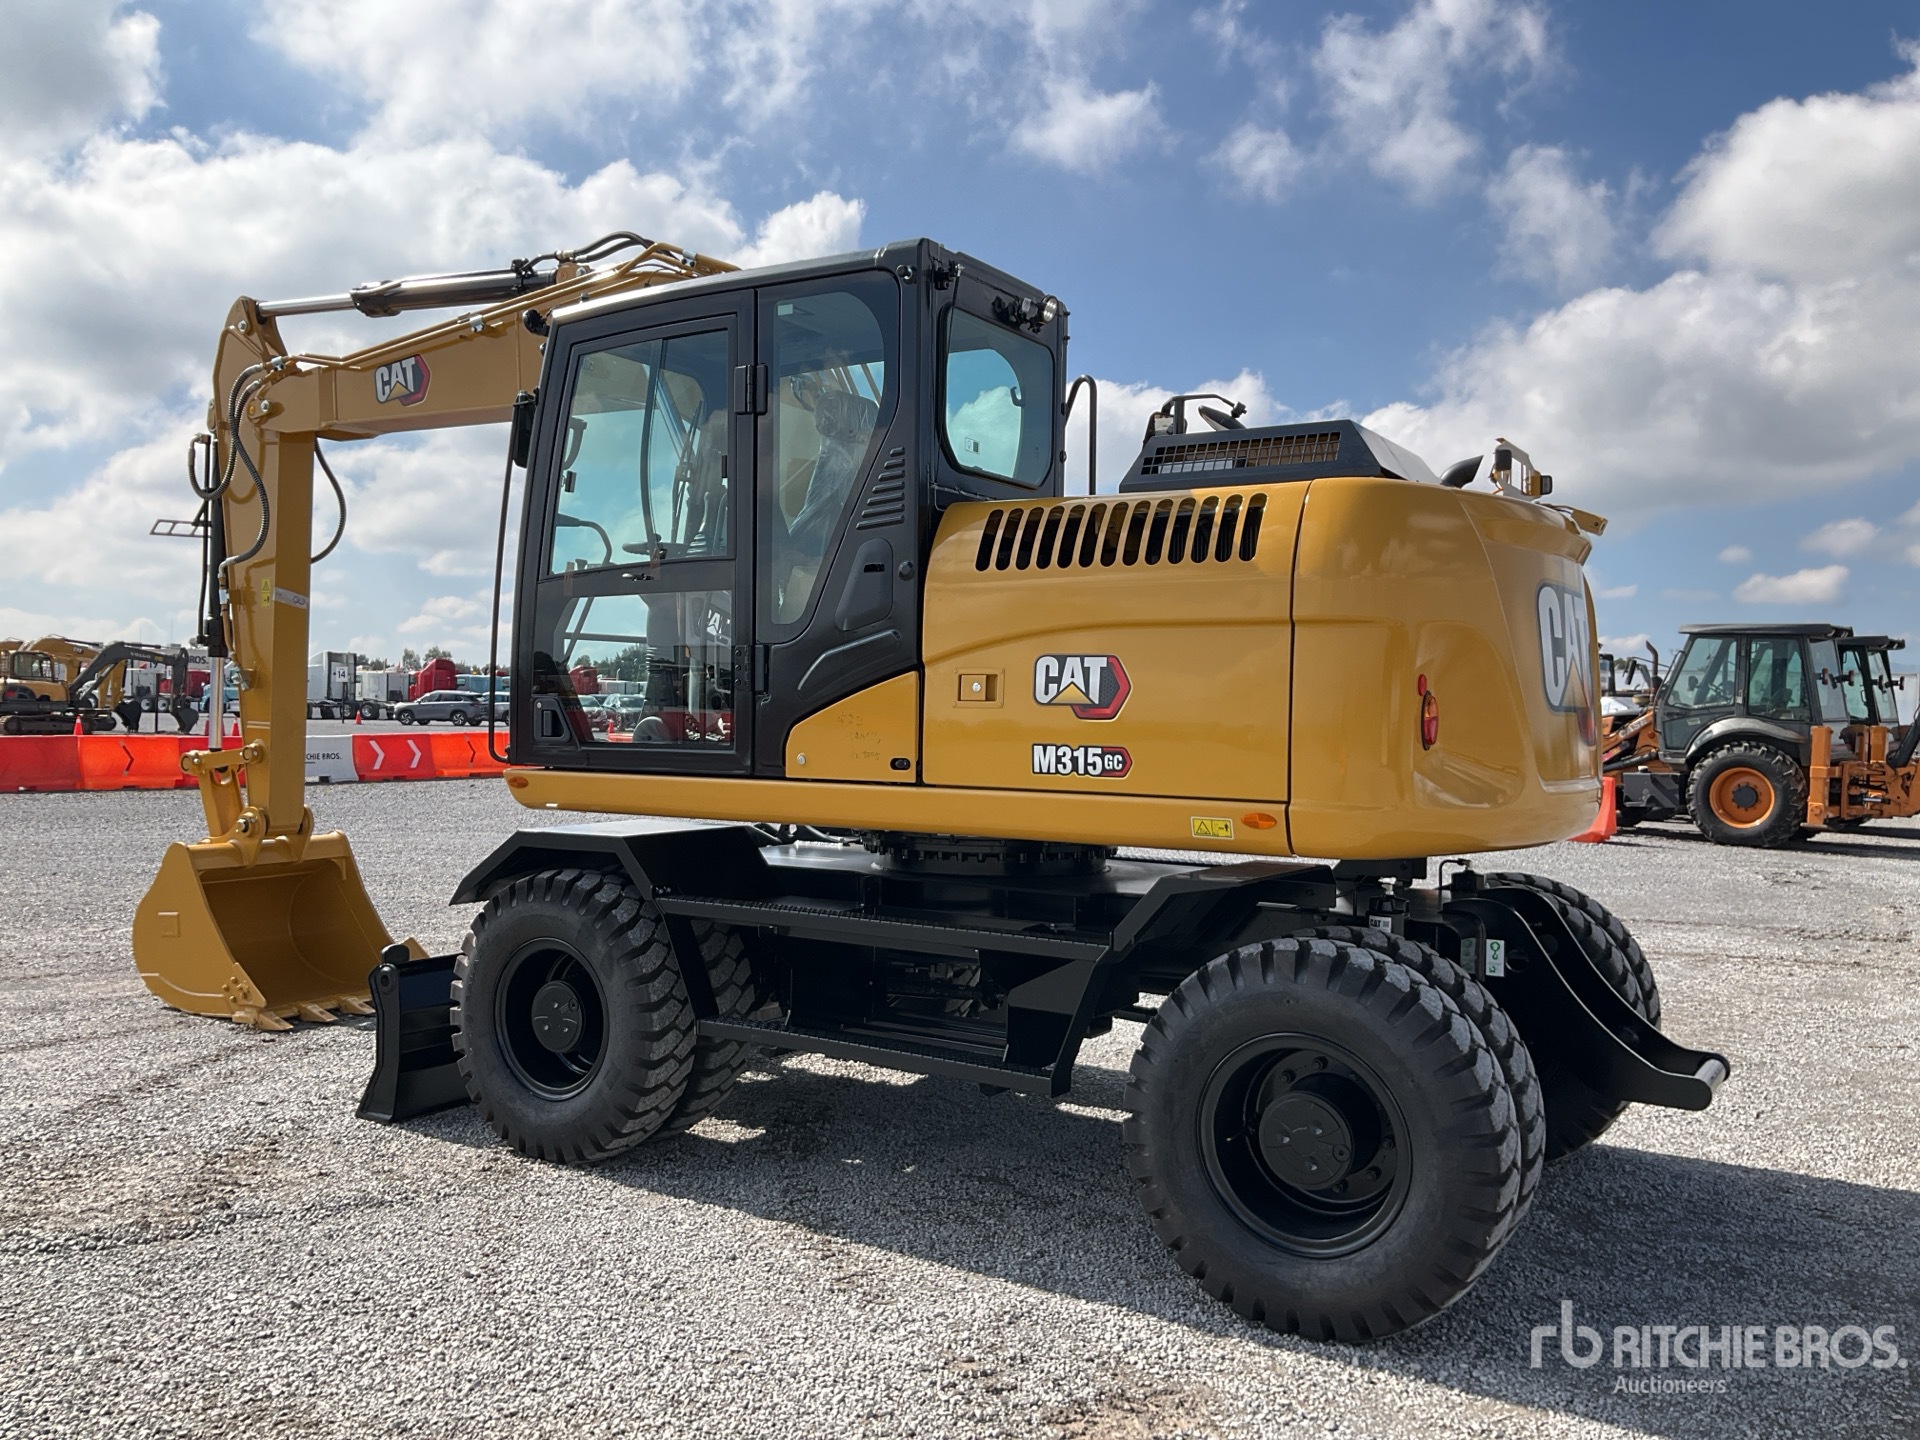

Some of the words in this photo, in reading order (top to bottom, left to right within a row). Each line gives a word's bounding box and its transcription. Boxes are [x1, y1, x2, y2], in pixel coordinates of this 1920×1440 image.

[375, 357, 416, 402] CAT
[1538, 586, 1593, 707] CAT
[337, 670, 346, 678] 14
[1036, 655, 1108, 705] CAT
[1618, 717, 1648, 738] CASE
[322, 752, 342, 760] BROS.
[1370, 919, 1381, 927] CAT
